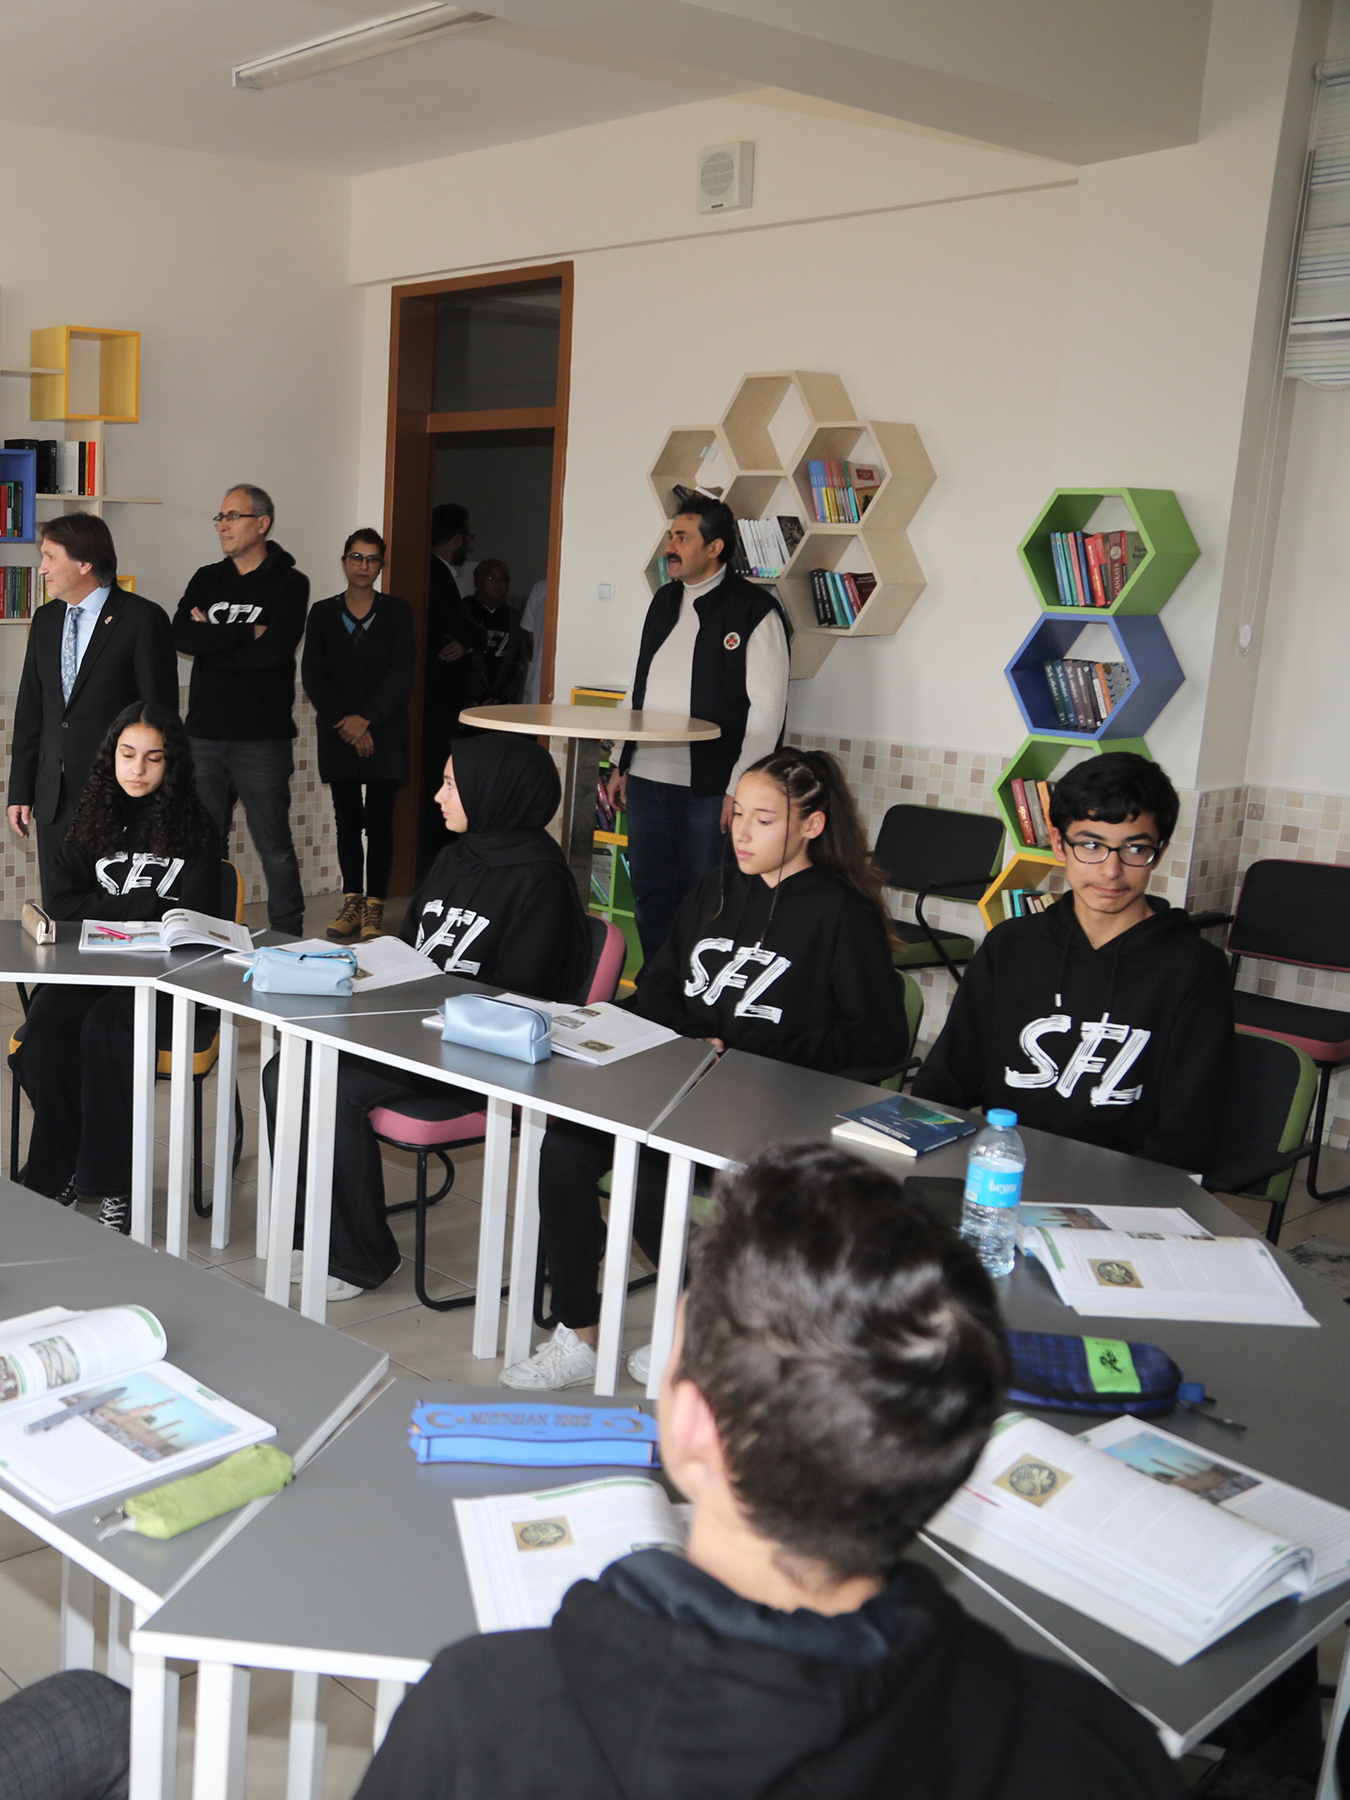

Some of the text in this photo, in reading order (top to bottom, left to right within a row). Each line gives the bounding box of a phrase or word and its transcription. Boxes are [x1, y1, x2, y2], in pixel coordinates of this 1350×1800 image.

[95, 850, 186, 901] SFL
[415, 899, 491, 976] SFL
[684, 937, 792, 1024] SFL
[1004, 1014, 1152, 1107] SFL
